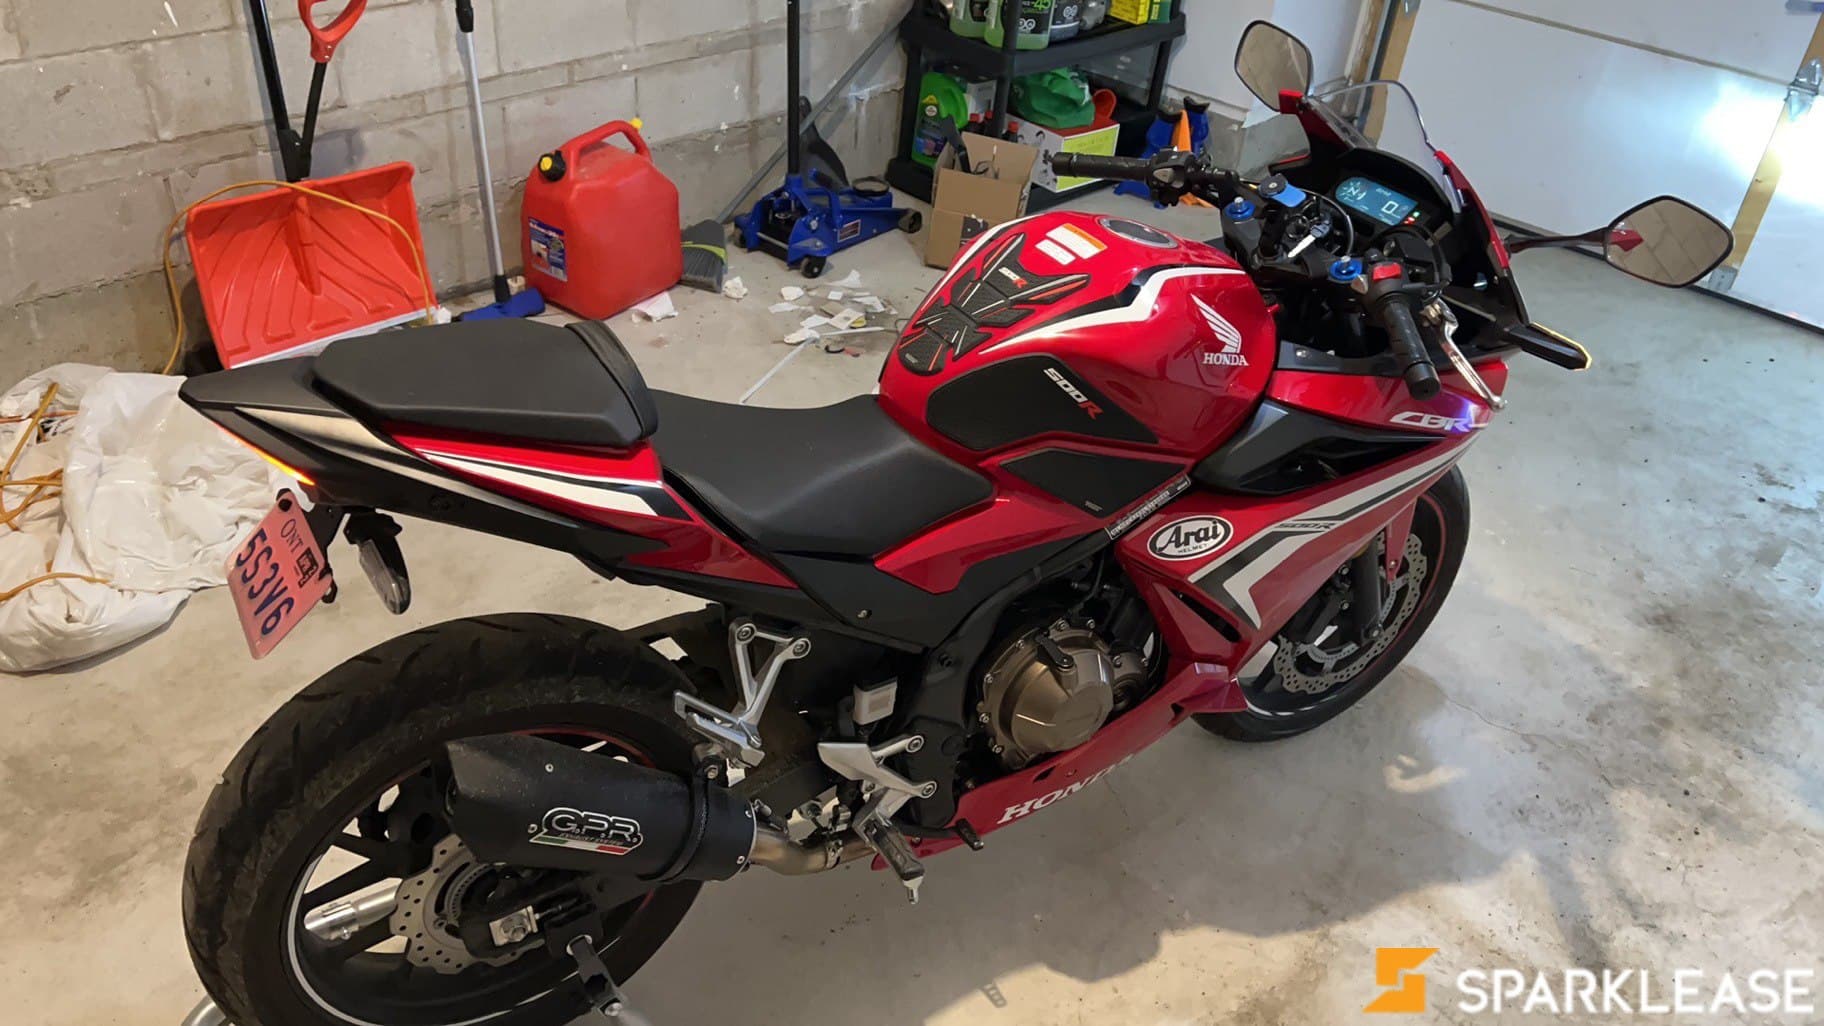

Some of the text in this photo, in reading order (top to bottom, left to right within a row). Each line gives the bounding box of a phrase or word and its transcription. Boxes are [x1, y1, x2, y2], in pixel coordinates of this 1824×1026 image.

[1381, 200, 1398, 214] 0
[1203, 352, 1249, 366] HONDA
[1043, 367, 1104, 420] 500R
[1390, 411, 1471, 432] CBR
[281, 518, 304, 552] ONT
[1157, 520, 1220, 552] Arai
[1178, 543, 1208, 553] HELMET
